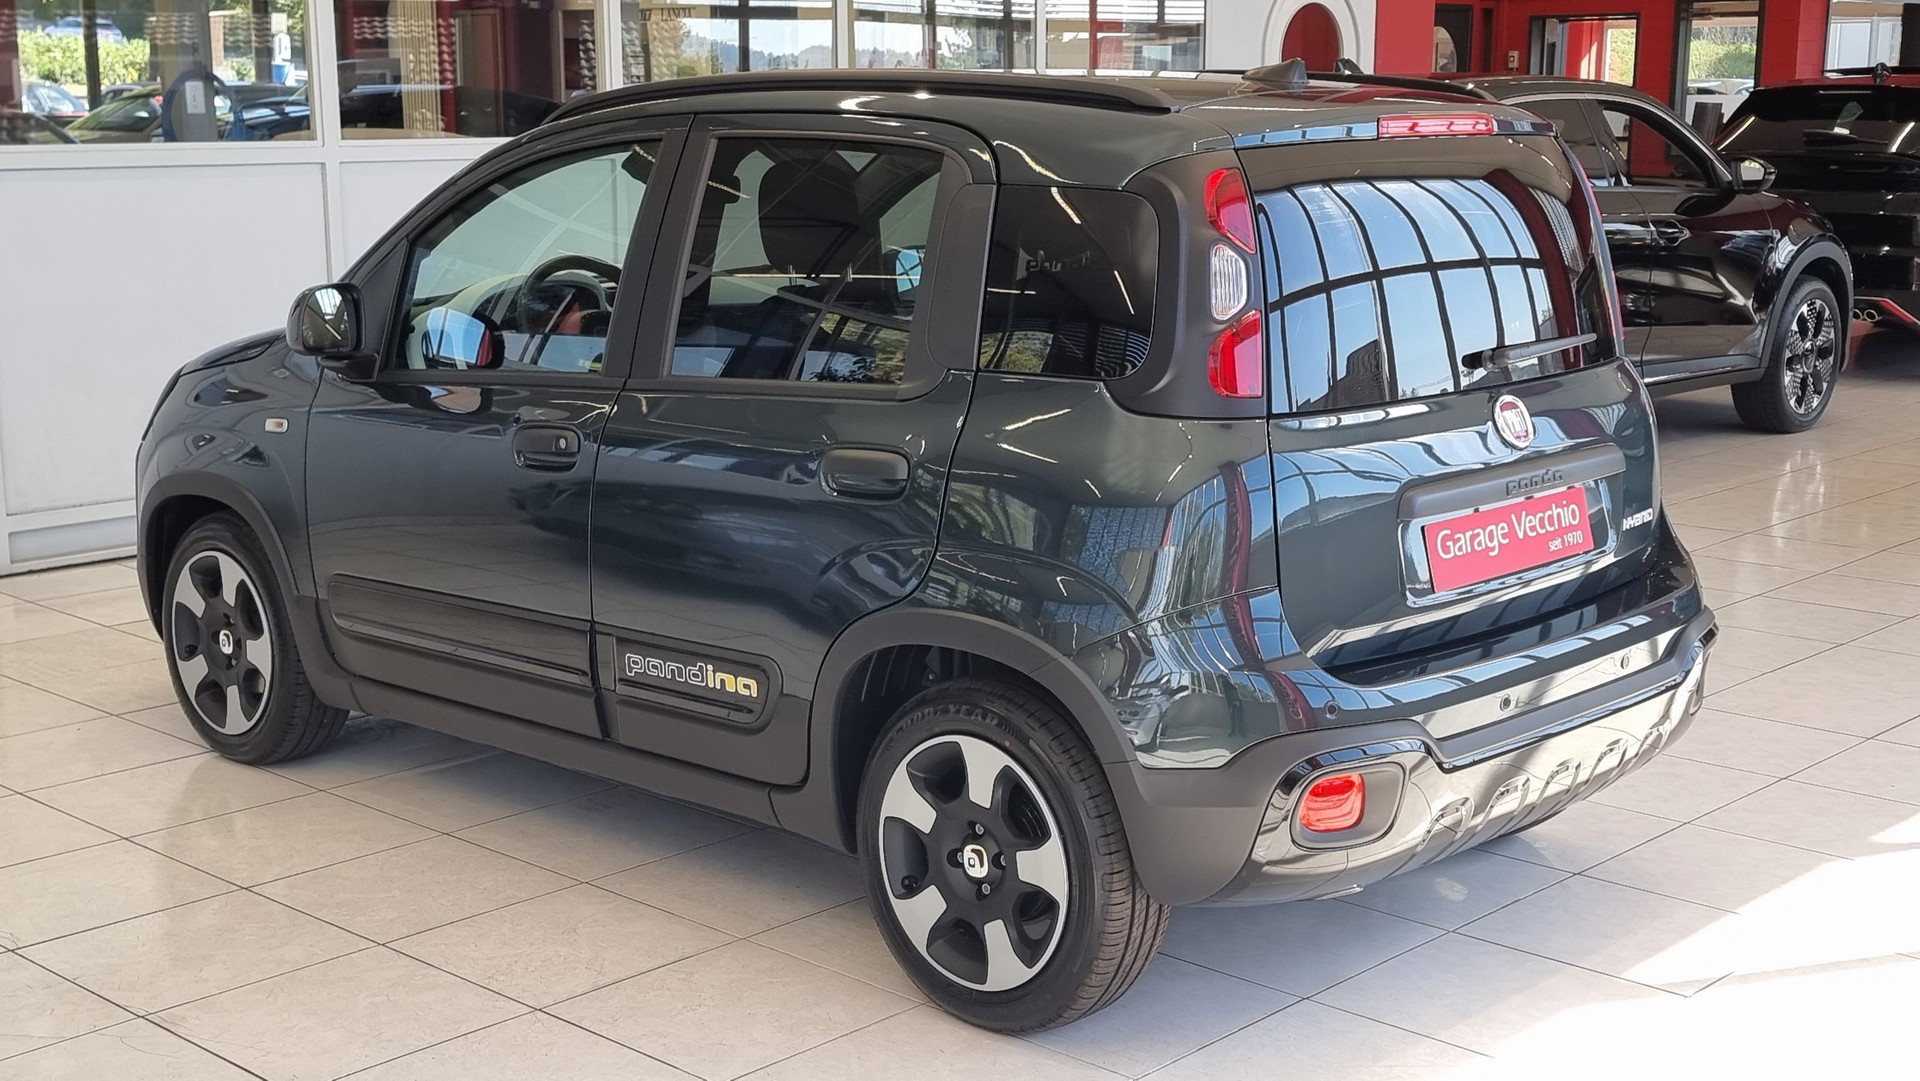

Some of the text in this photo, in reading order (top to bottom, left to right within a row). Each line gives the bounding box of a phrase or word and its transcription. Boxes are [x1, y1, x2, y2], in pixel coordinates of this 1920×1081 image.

[1437, 500, 1580, 559] Garage Vecchio
[1548, 530, 1584, 552] seit 1970
[625, 653, 758, 698] pandina
